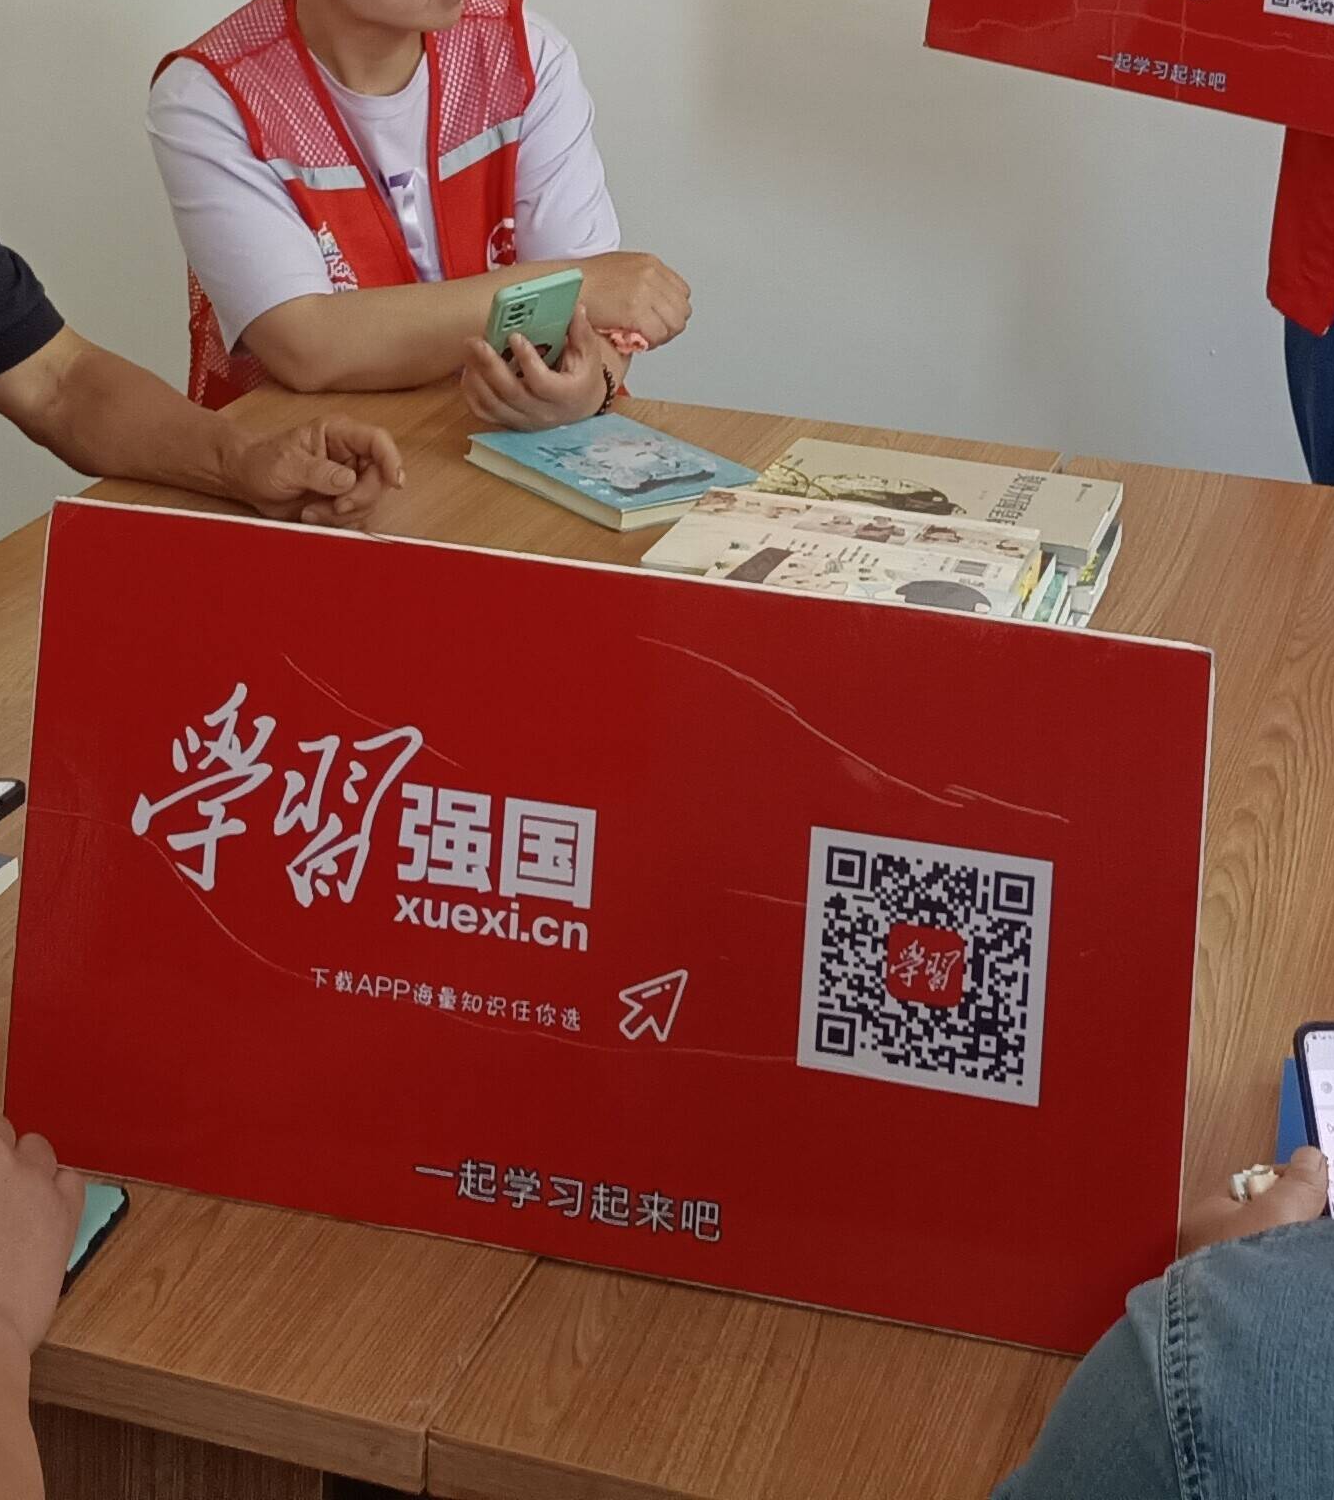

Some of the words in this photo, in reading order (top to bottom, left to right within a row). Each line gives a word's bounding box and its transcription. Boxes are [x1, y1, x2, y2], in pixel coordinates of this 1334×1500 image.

[1097, 51, 1227, 92] 一起学习起来吧
[393, 891, 590, 953] xuexi.cn
[308, 966, 583, 1033] 下载APP海量知识任你选
[413, 1156, 722, 1243] 一起学习起来吧
